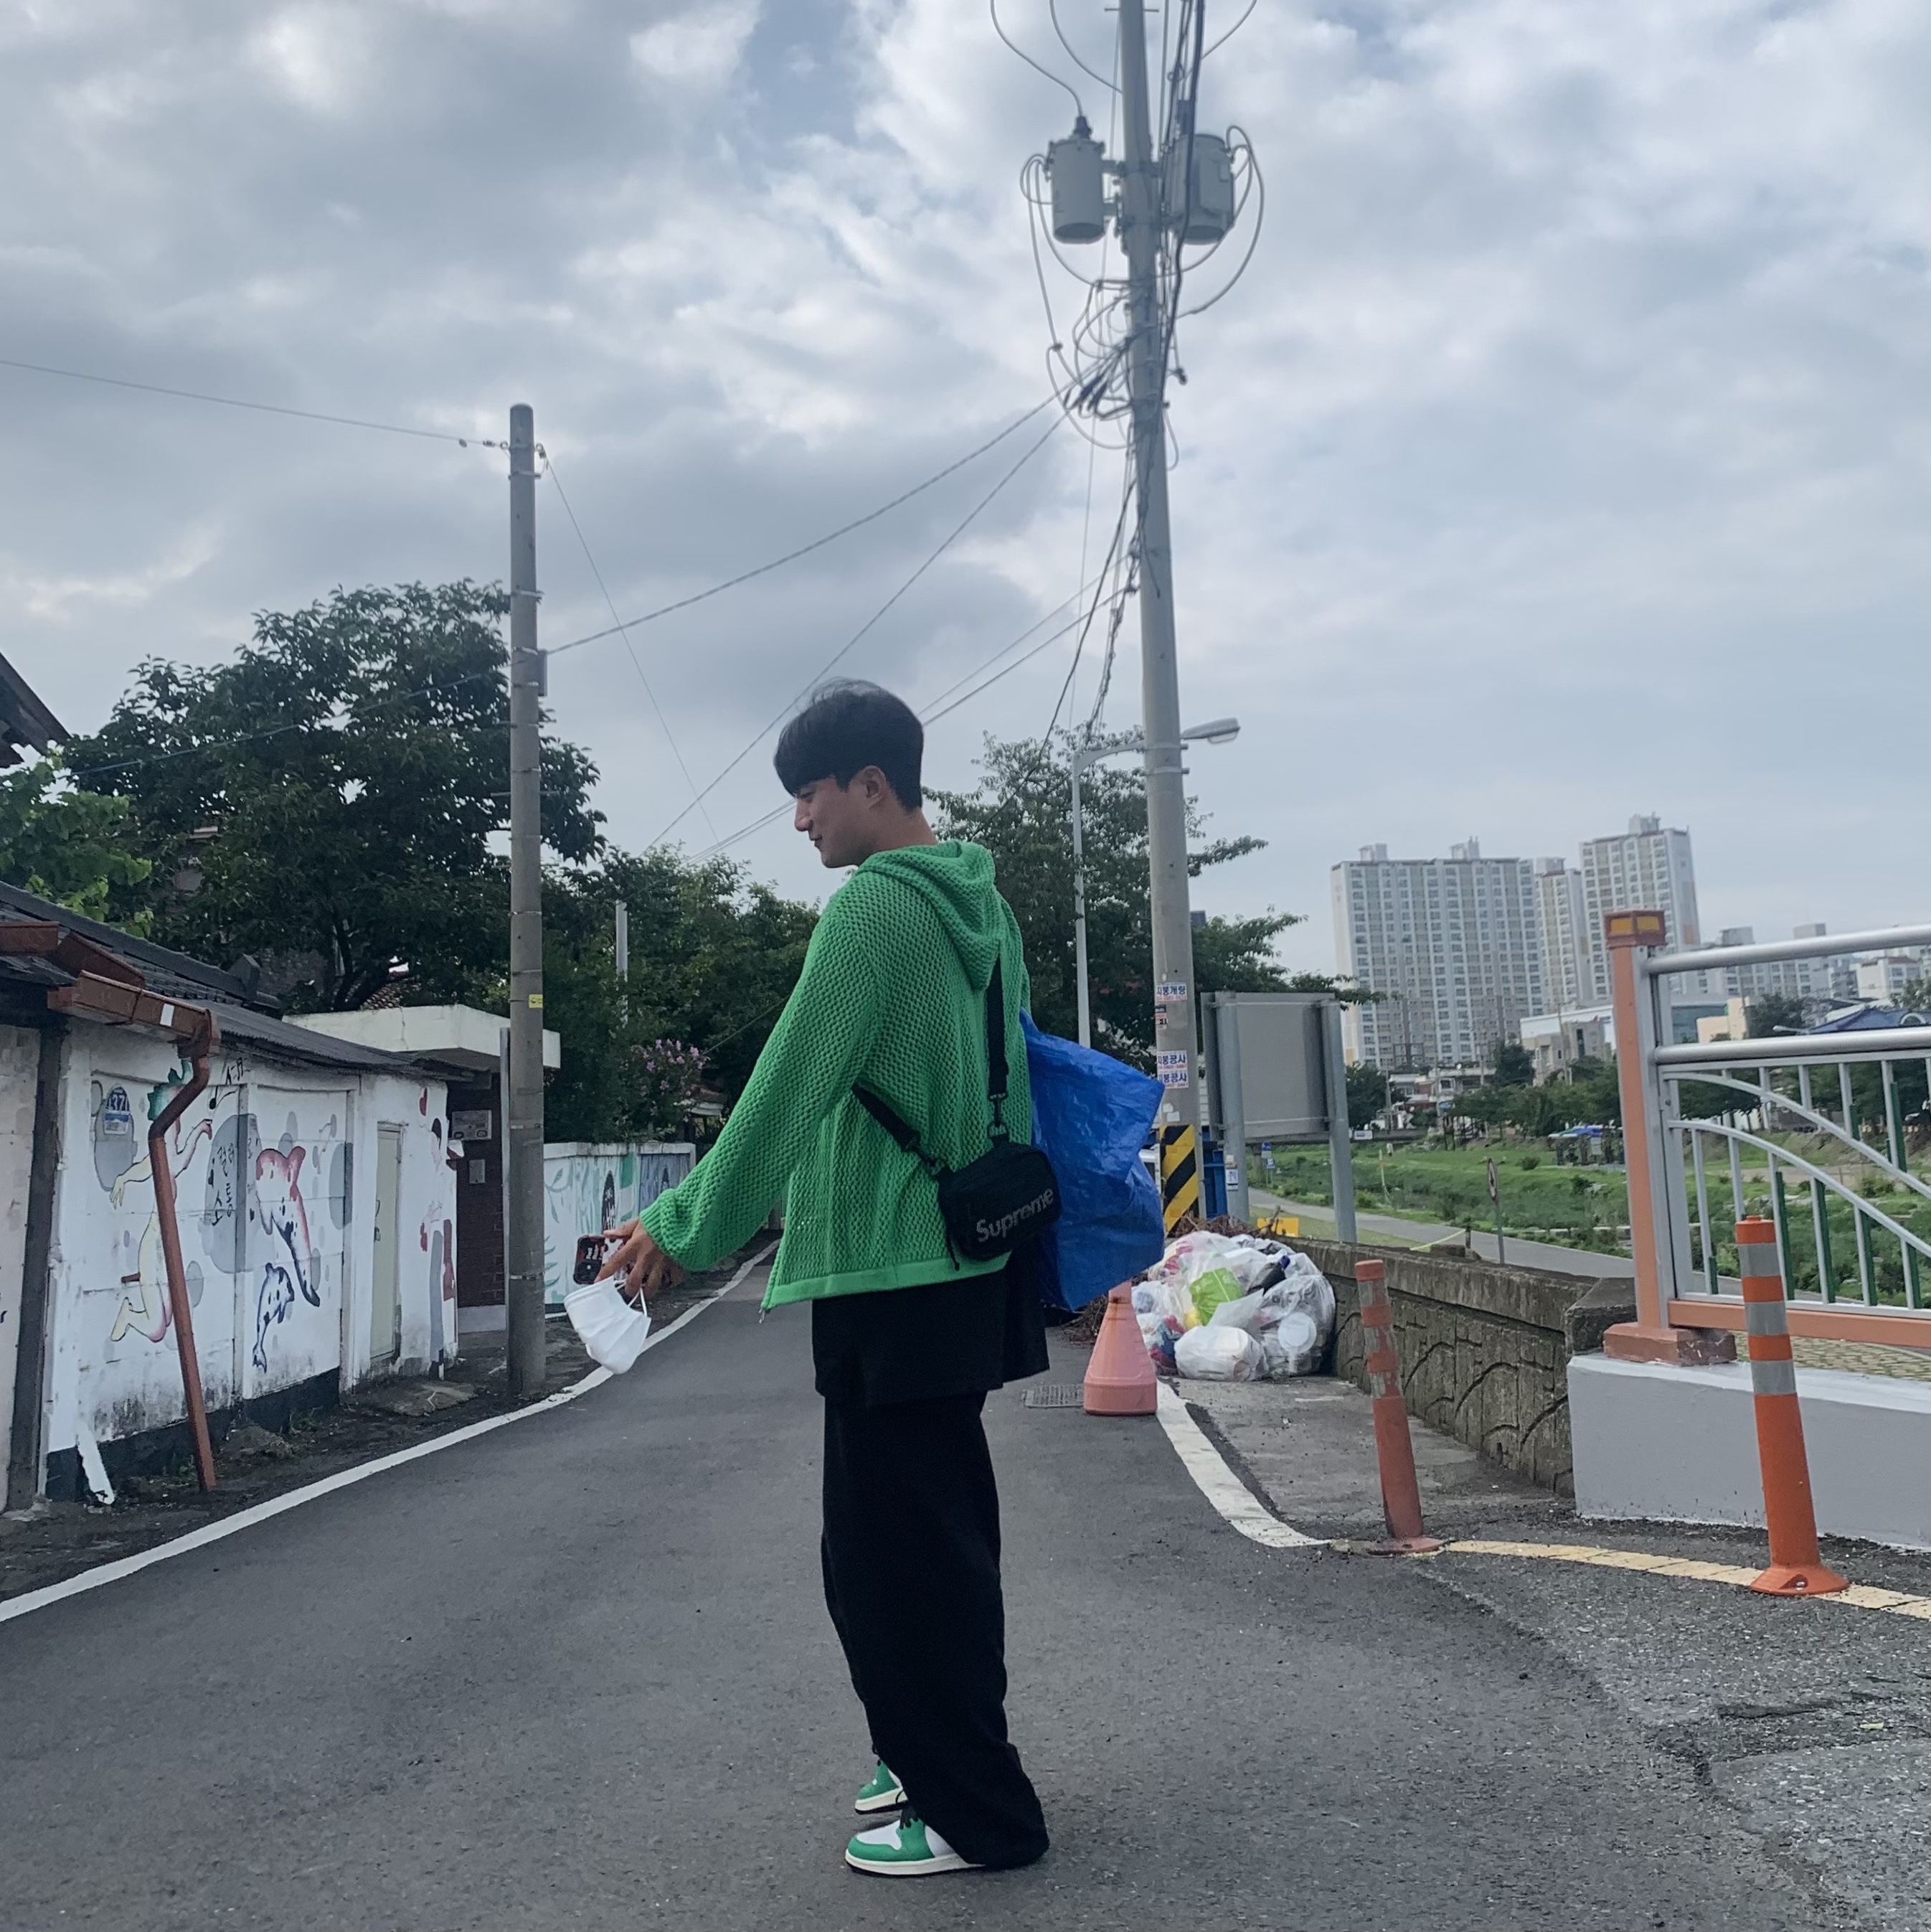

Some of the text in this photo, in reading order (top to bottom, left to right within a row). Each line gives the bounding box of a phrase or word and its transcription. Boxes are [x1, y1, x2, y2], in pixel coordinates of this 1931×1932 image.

[1156, 986, 1186, 995] 지붕개량
[1158, 1055, 1186, 1065] 지붕공사
[976, 1188, 1054, 1243] Supreme
